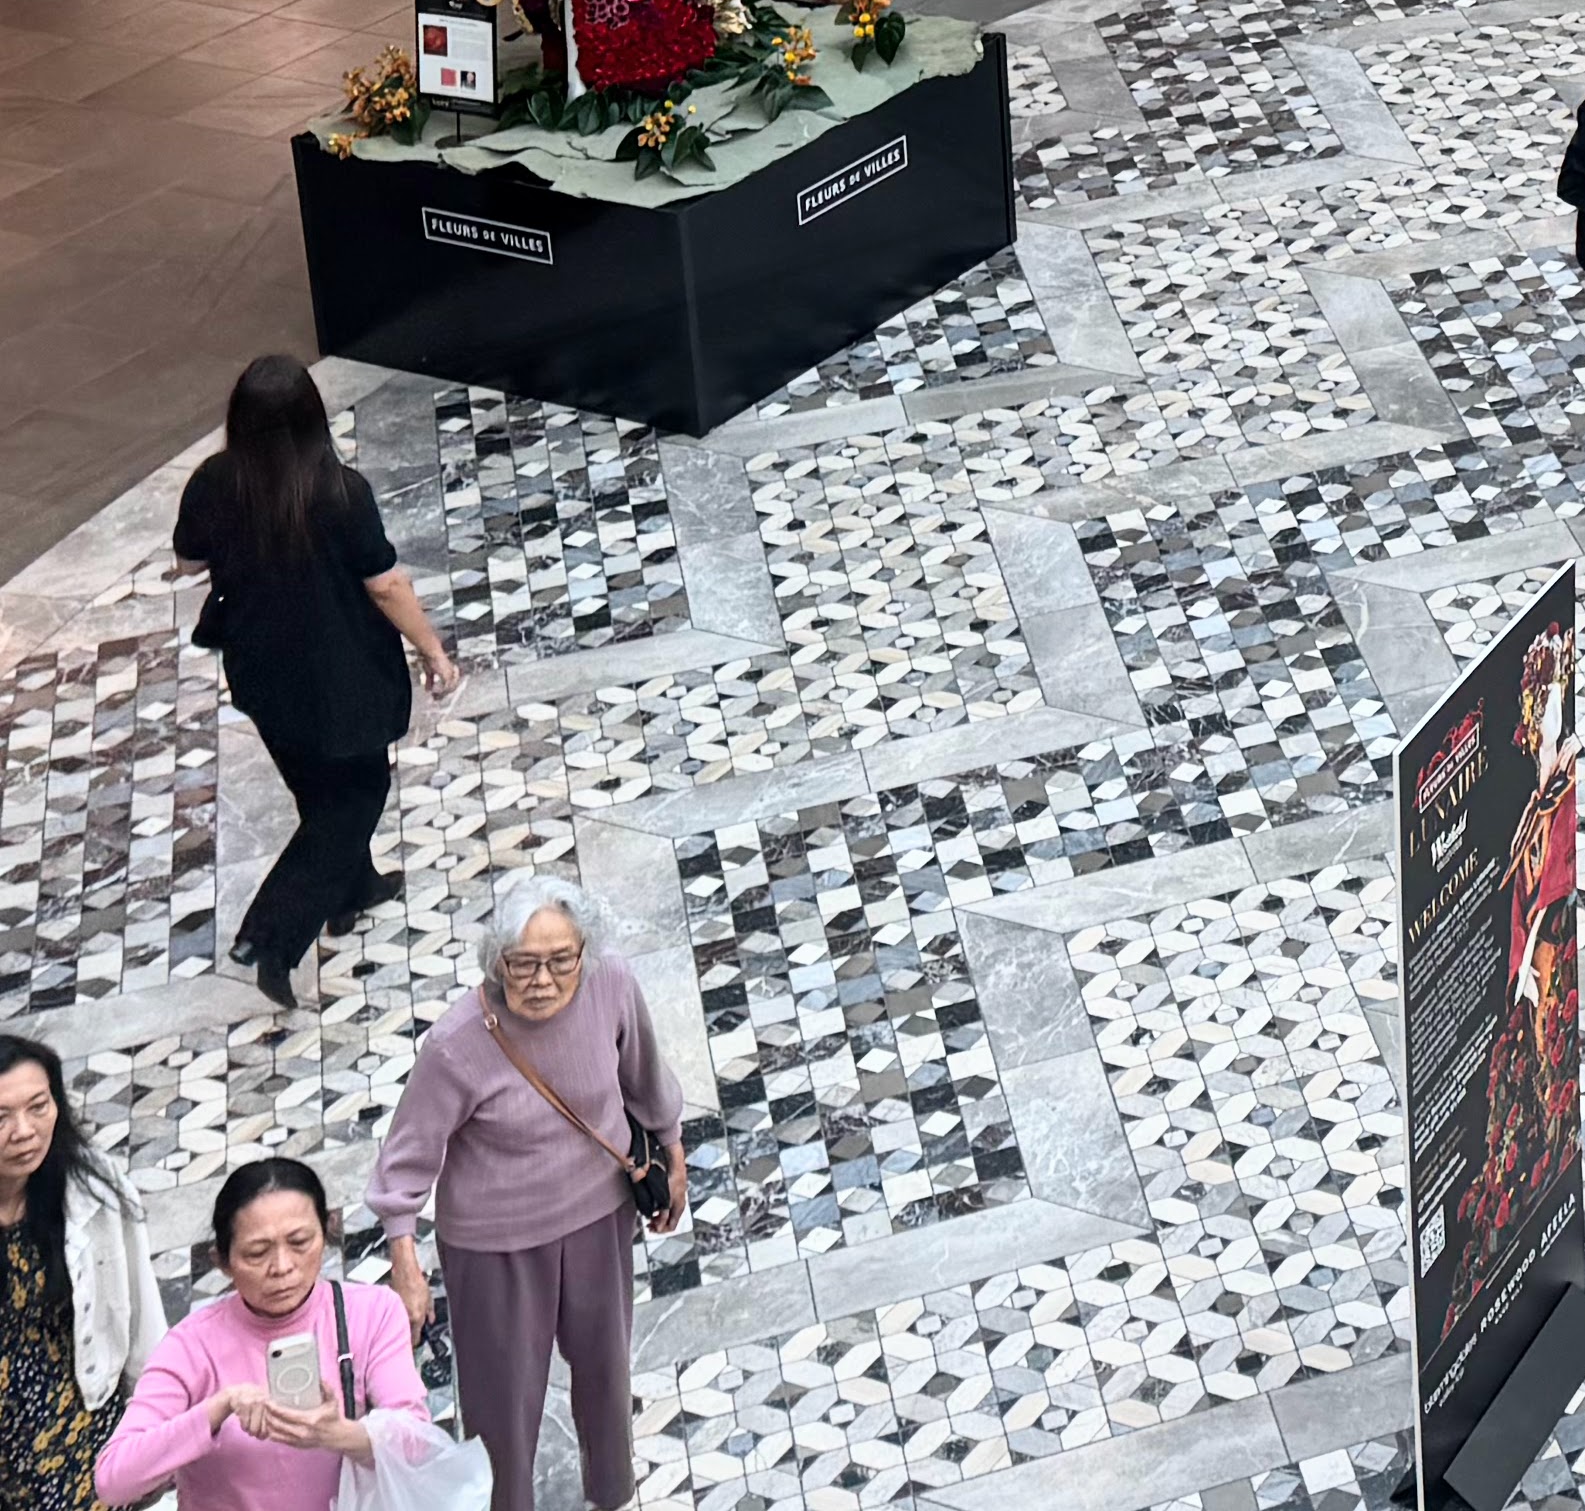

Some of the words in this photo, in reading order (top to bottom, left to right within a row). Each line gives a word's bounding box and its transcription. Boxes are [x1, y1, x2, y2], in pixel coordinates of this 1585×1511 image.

[805, 178, 846, 212] FLEURS
[849, 171, 860, 186] DE
[864, 148, 901, 177] VILLES
[432, 218, 479, 239] FLEURS
[483, 230, 496, 242] DE
[500, 232, 544, 253] VILLES
[1455, 735, 1477, 763] VILLES
[1410, 745, 1489, 858] LUNAIRE
[1408, 848, 1479, 943] WELCOME
[1480, 1249, 1536, 1332] ROSEWOOD
